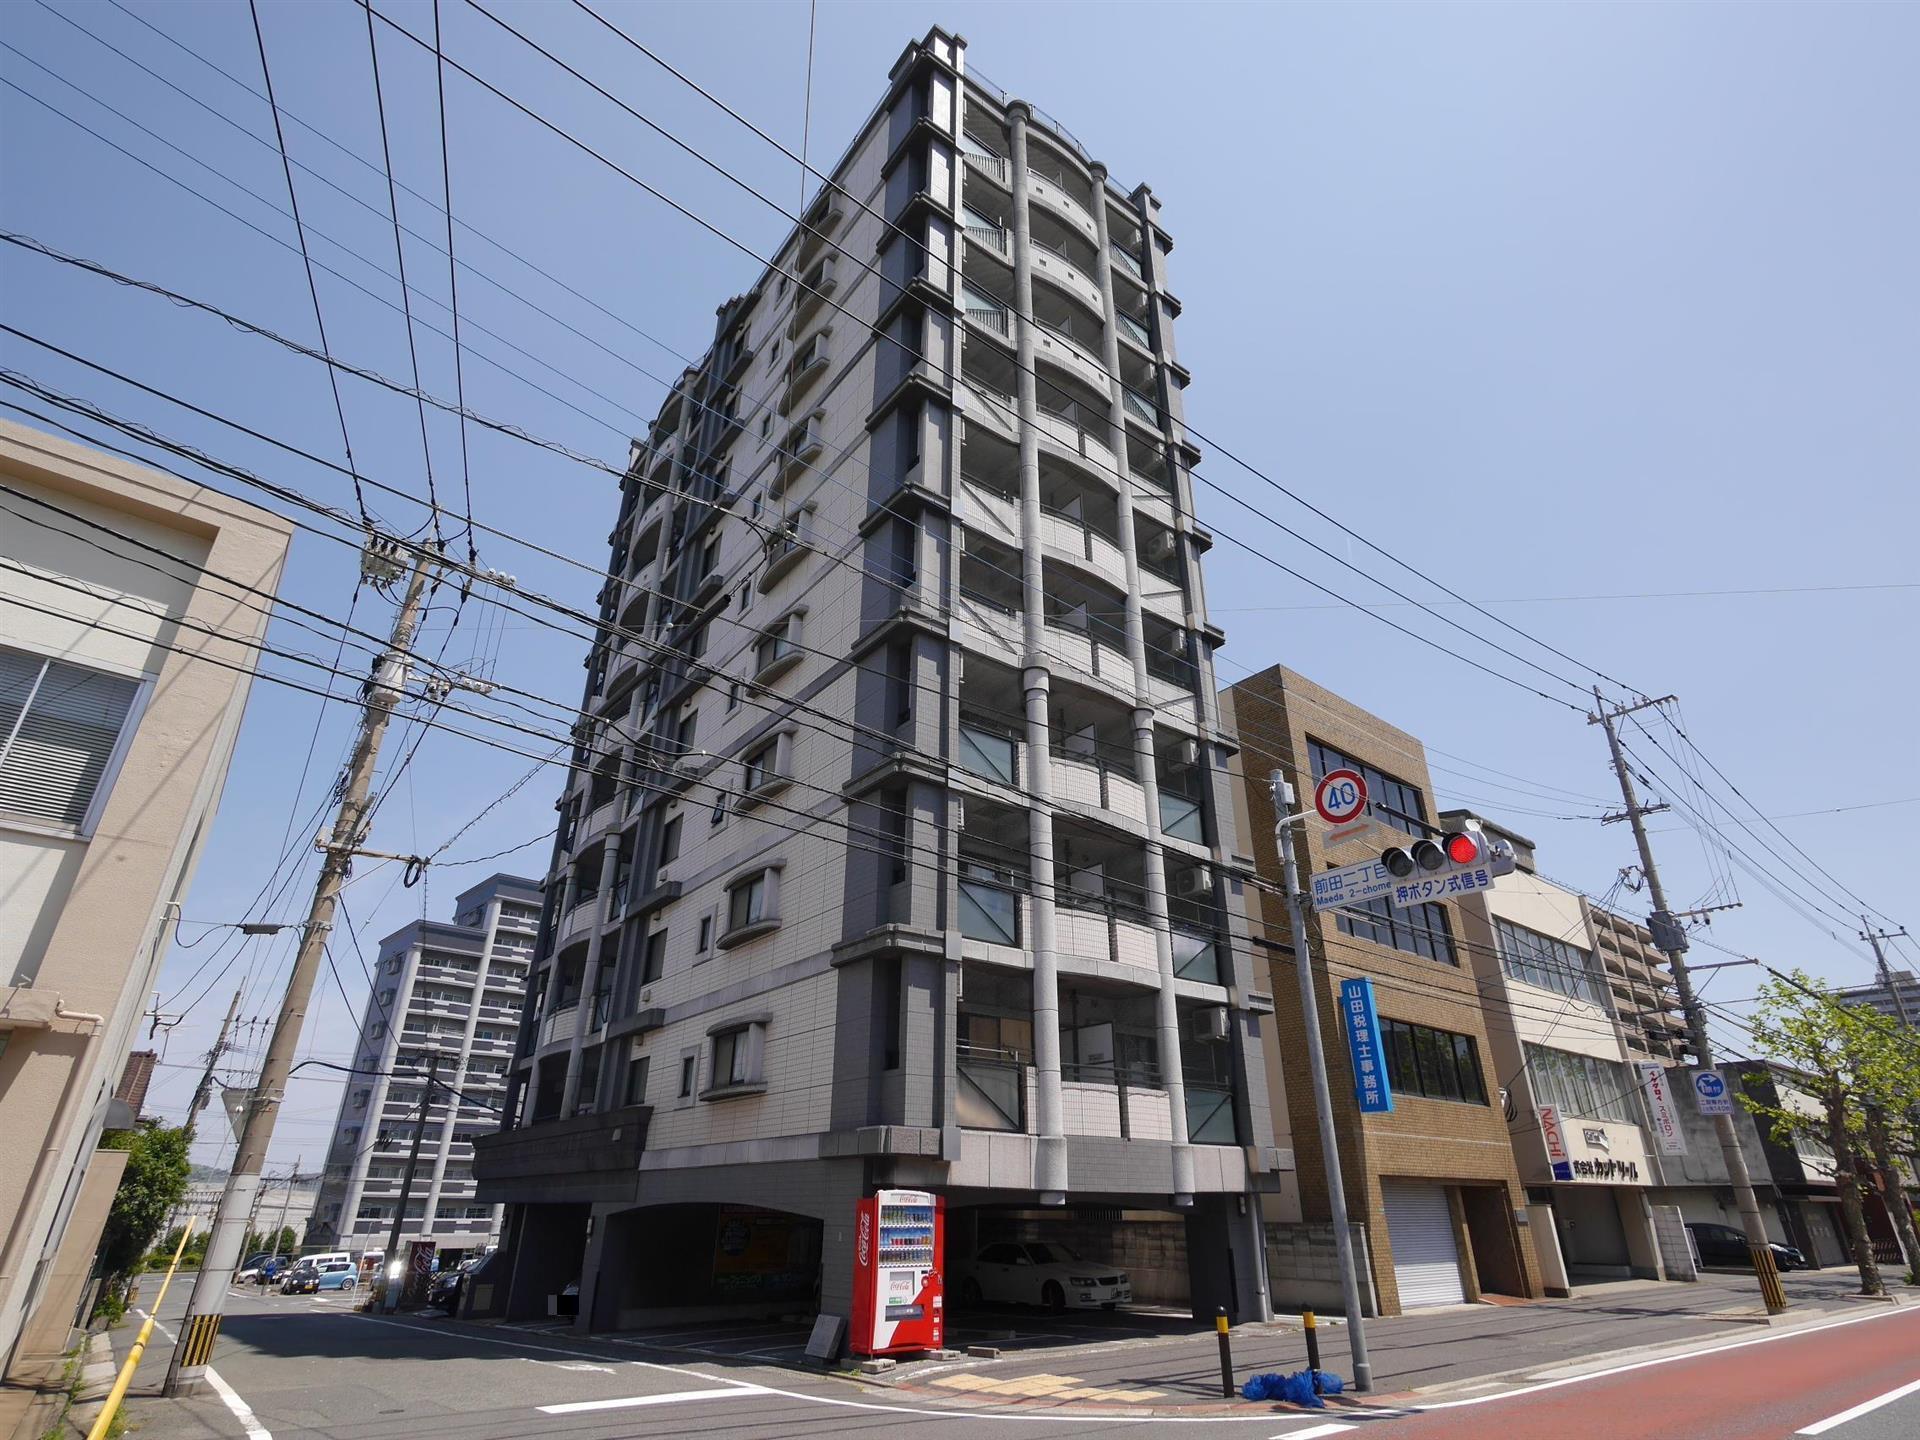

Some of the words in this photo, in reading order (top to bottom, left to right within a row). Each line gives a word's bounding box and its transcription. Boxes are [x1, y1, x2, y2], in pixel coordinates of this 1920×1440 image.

[1328, 782, 1356, 810] 40
[1315, 863, 1388, 895] 前田二丁目
[1316, 893, 1344, 906] Maeda
[1350, 881, 1392, 897] 2-chome
[1395, 869, 1489, 903] 押ボタン式信号
[1348, 985, 1379, 1105] 山田税理士事務所
[858, 1212, 870, 1266] Coca-Cola
